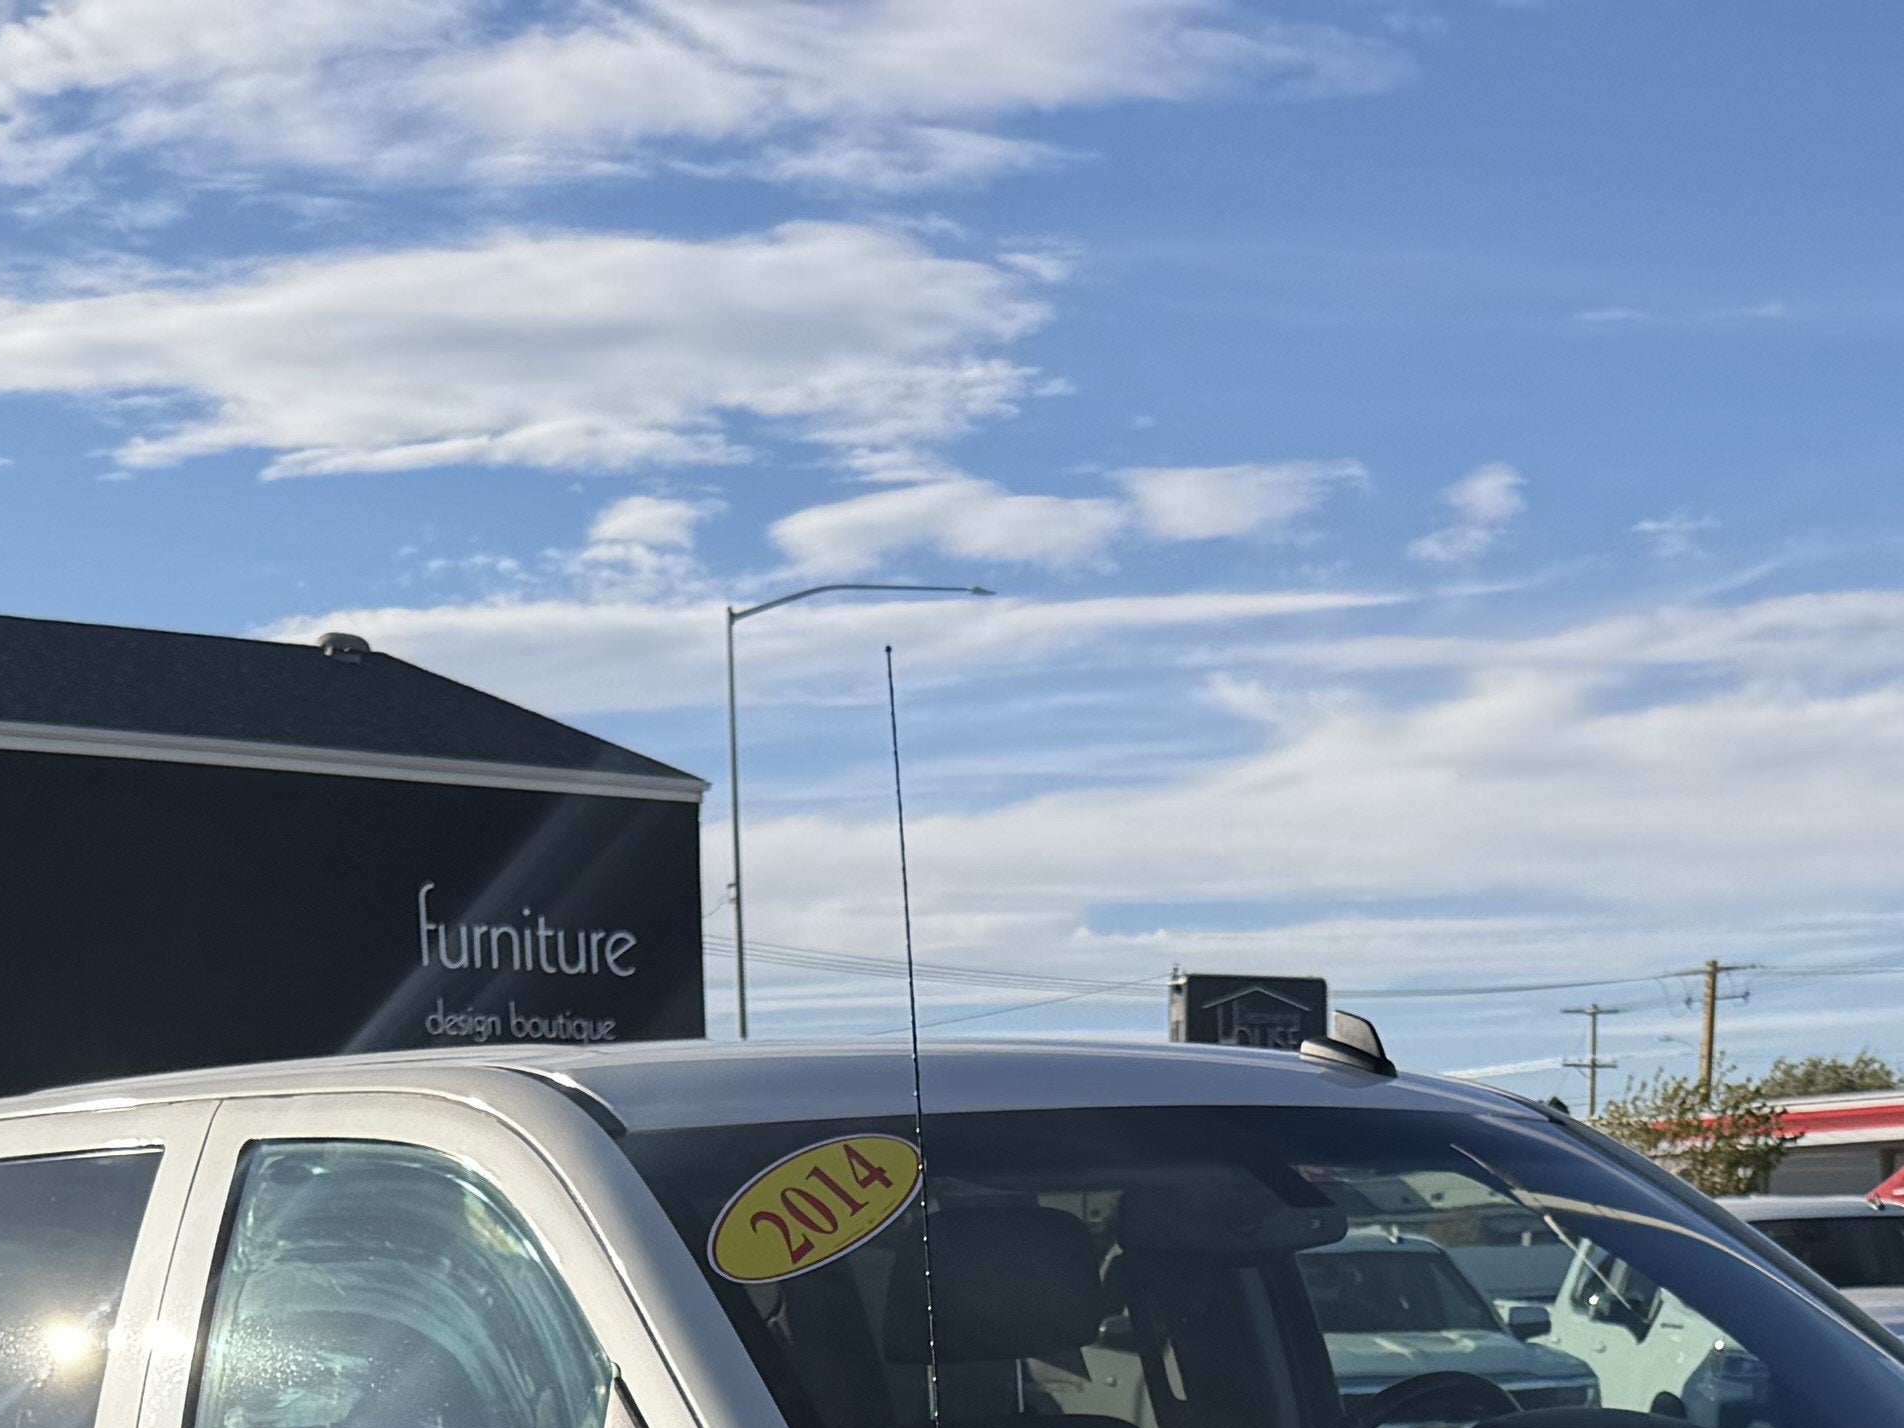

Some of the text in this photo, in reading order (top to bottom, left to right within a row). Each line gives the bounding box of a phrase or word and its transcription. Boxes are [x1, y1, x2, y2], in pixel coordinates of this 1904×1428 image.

[418, 881, 638, 977] furniture
[425, 997, 617, 1045] design boutique
[749, 1142, 895, 1266] 2014
